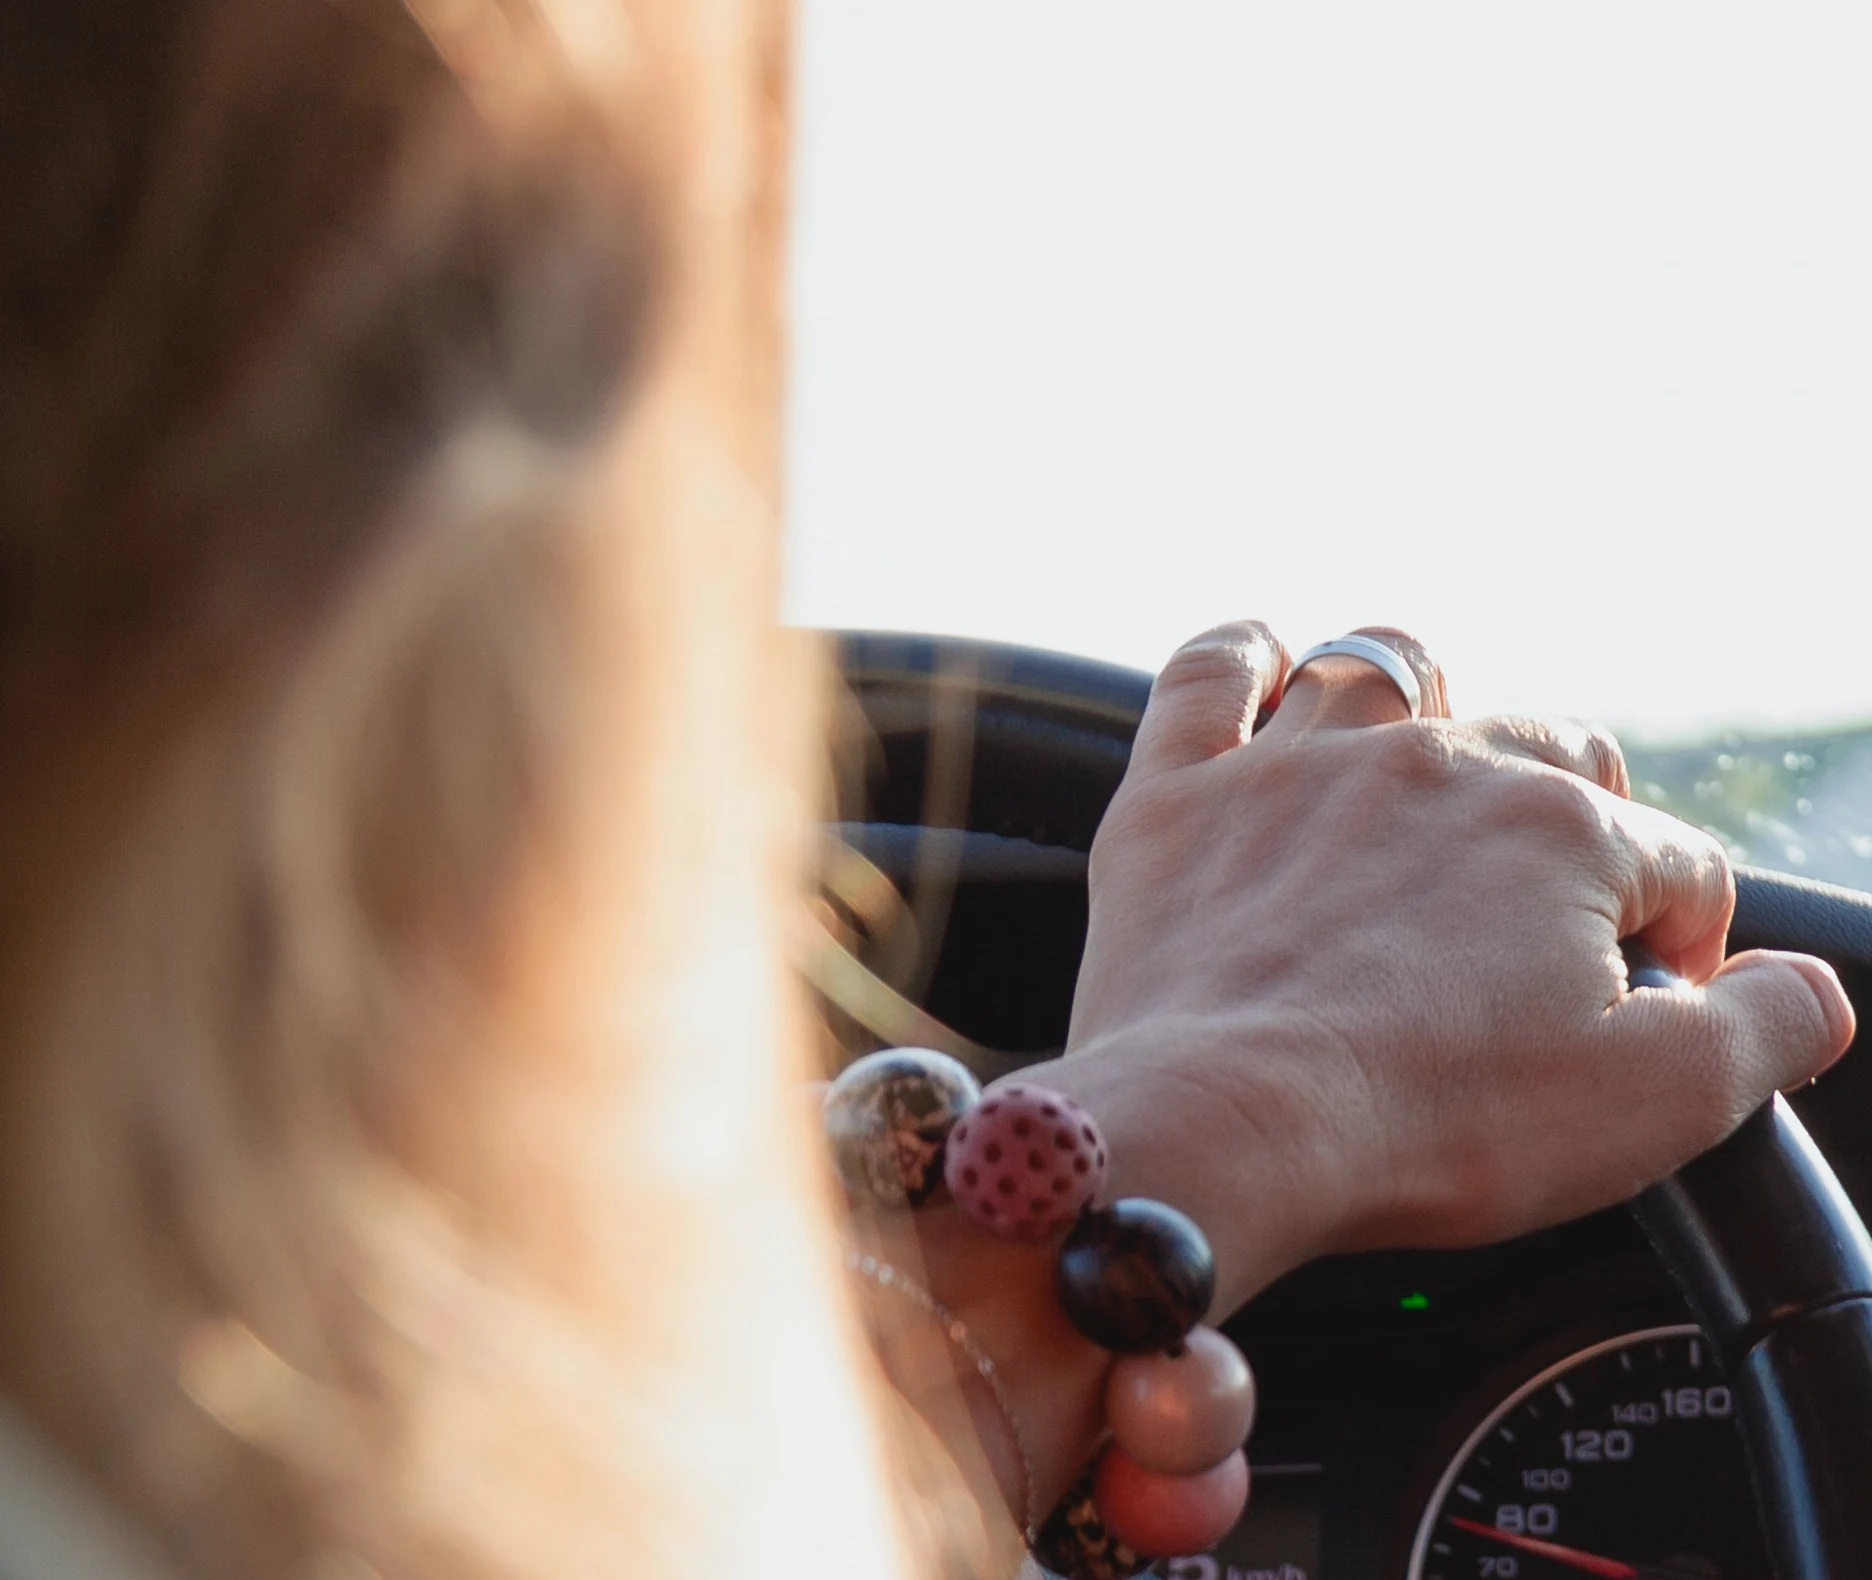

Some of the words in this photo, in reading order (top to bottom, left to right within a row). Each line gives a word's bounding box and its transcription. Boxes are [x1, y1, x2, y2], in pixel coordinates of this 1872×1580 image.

[1611, 1402, 1659, 1424] 140
[1661, 1385, 1733, 1418] 160
[1560, 1429, 1634, 1462] 120
[1521, 1468, 1572, 1491] 100
[1495, 1503, 1558, 1535] 80
[1477, 1556, 1518, 1579] 70
